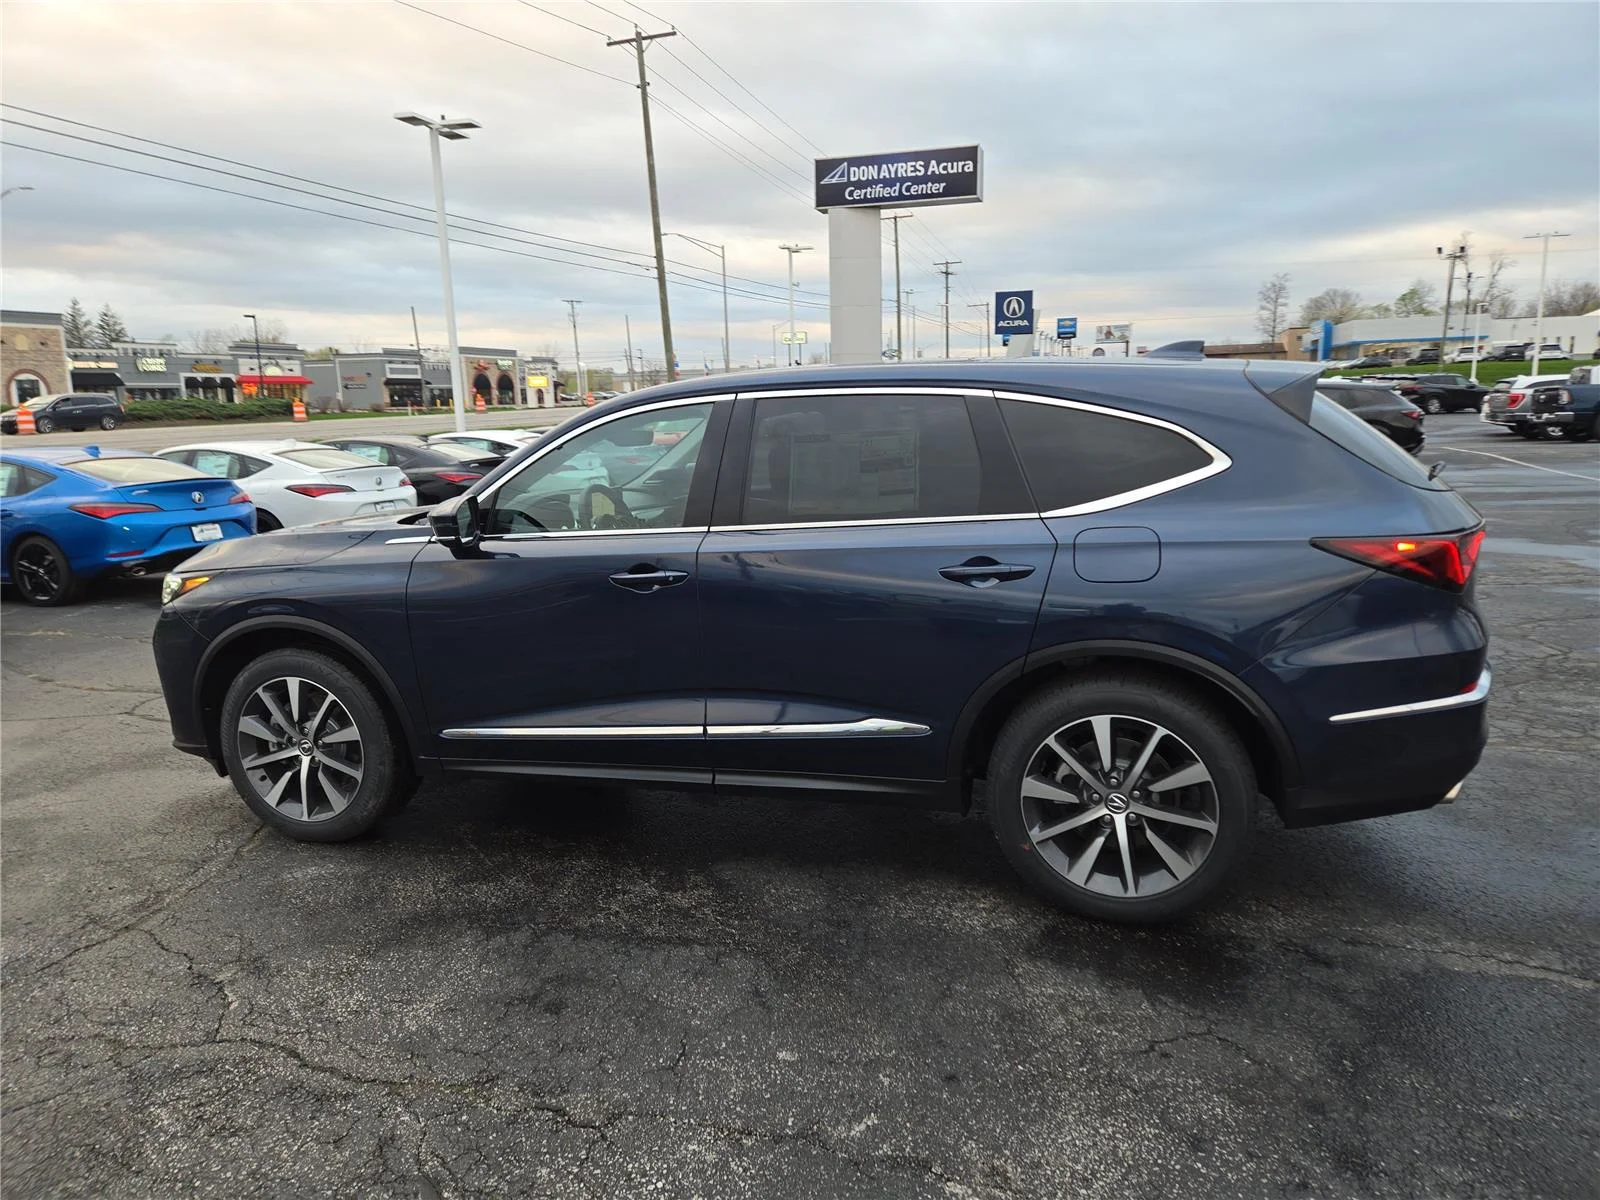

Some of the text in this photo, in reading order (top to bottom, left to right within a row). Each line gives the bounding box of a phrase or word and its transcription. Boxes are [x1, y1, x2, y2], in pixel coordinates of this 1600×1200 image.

[927, 160, 973, 175] Acura
[844, 182, 946, 200] Certified Center
